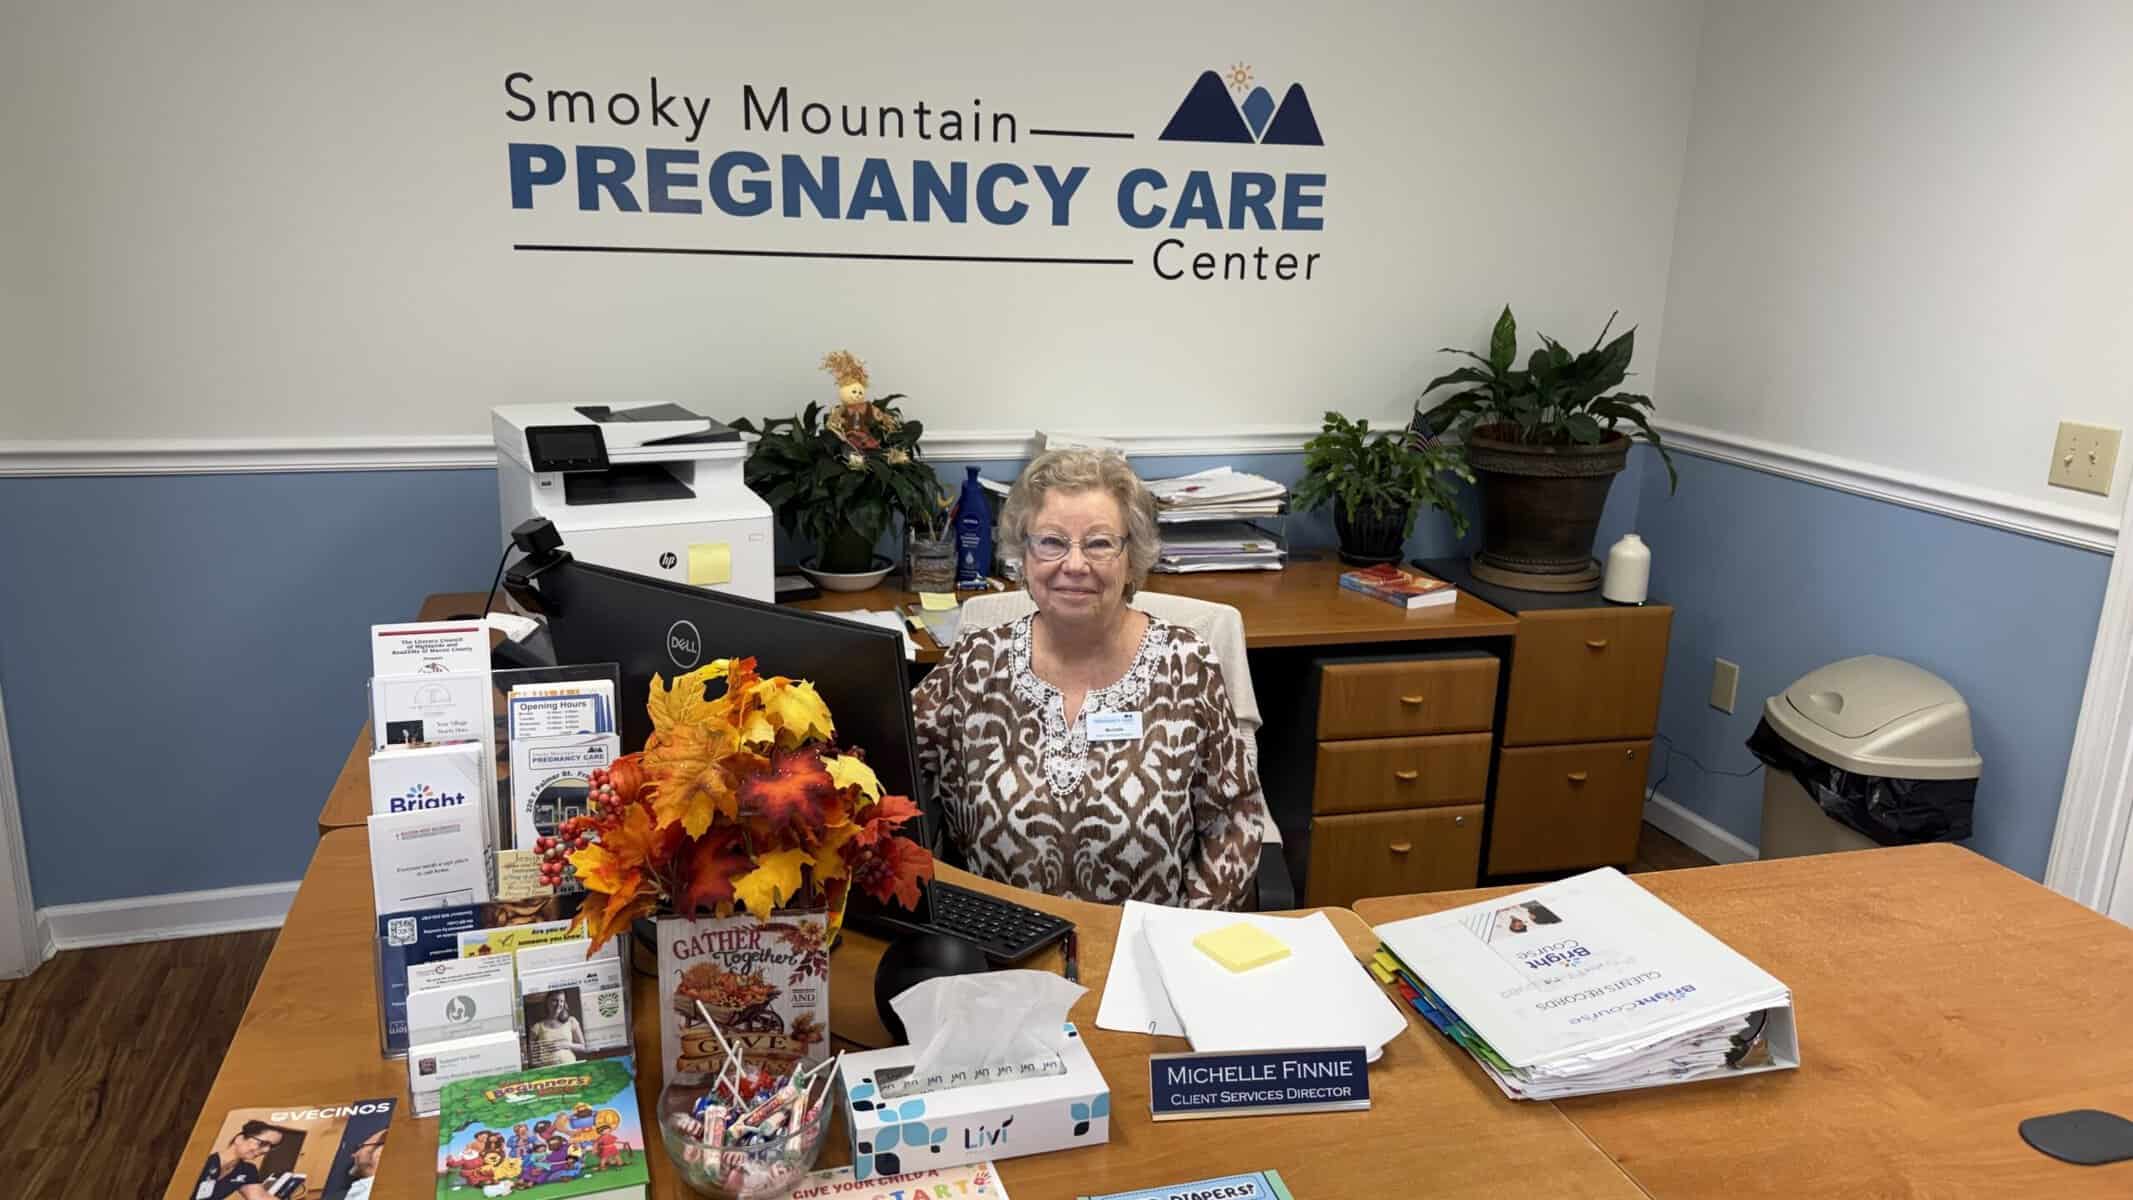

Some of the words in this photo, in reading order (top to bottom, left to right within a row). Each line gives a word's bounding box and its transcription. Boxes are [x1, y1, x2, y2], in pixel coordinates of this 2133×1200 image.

[504, 71, 711, 143] Smoky
[742, 84, 1019, 144] Mountain
[507, 142, 1091, 227] PREGNANCY
[1116, 168, 1327, 232] CARE
[1152, 238, 1322, 281] Center
[660, 552, 677, 570] hp
[671, 635, 697, 655] DELL
[520, 703, 558, 712] Opening
[560, 701, 587, 709] Hours
[390, 792, 465, 813] Bright
[672, 928, 761, 960] GATHER
[1516, 939, 1579, 960] Course
[712, 948, 798, 976] Together
[1525, 946, 1592, 969] Bright
[1604, 970, 1662, 993] CLIENTS
[791, 993, 816, 1002] AND
[1535, 988, 1605, 1011] RECORDS
[1568, 984, 1697, 1025] BrightCourse
[698, 1035, 787, 1053] GIVE
[291, 1102, 391, 1121] VECINOS
[792, 1187, 830, 1200] GIVE
[833, 1180, 875, 1194] YOUR
